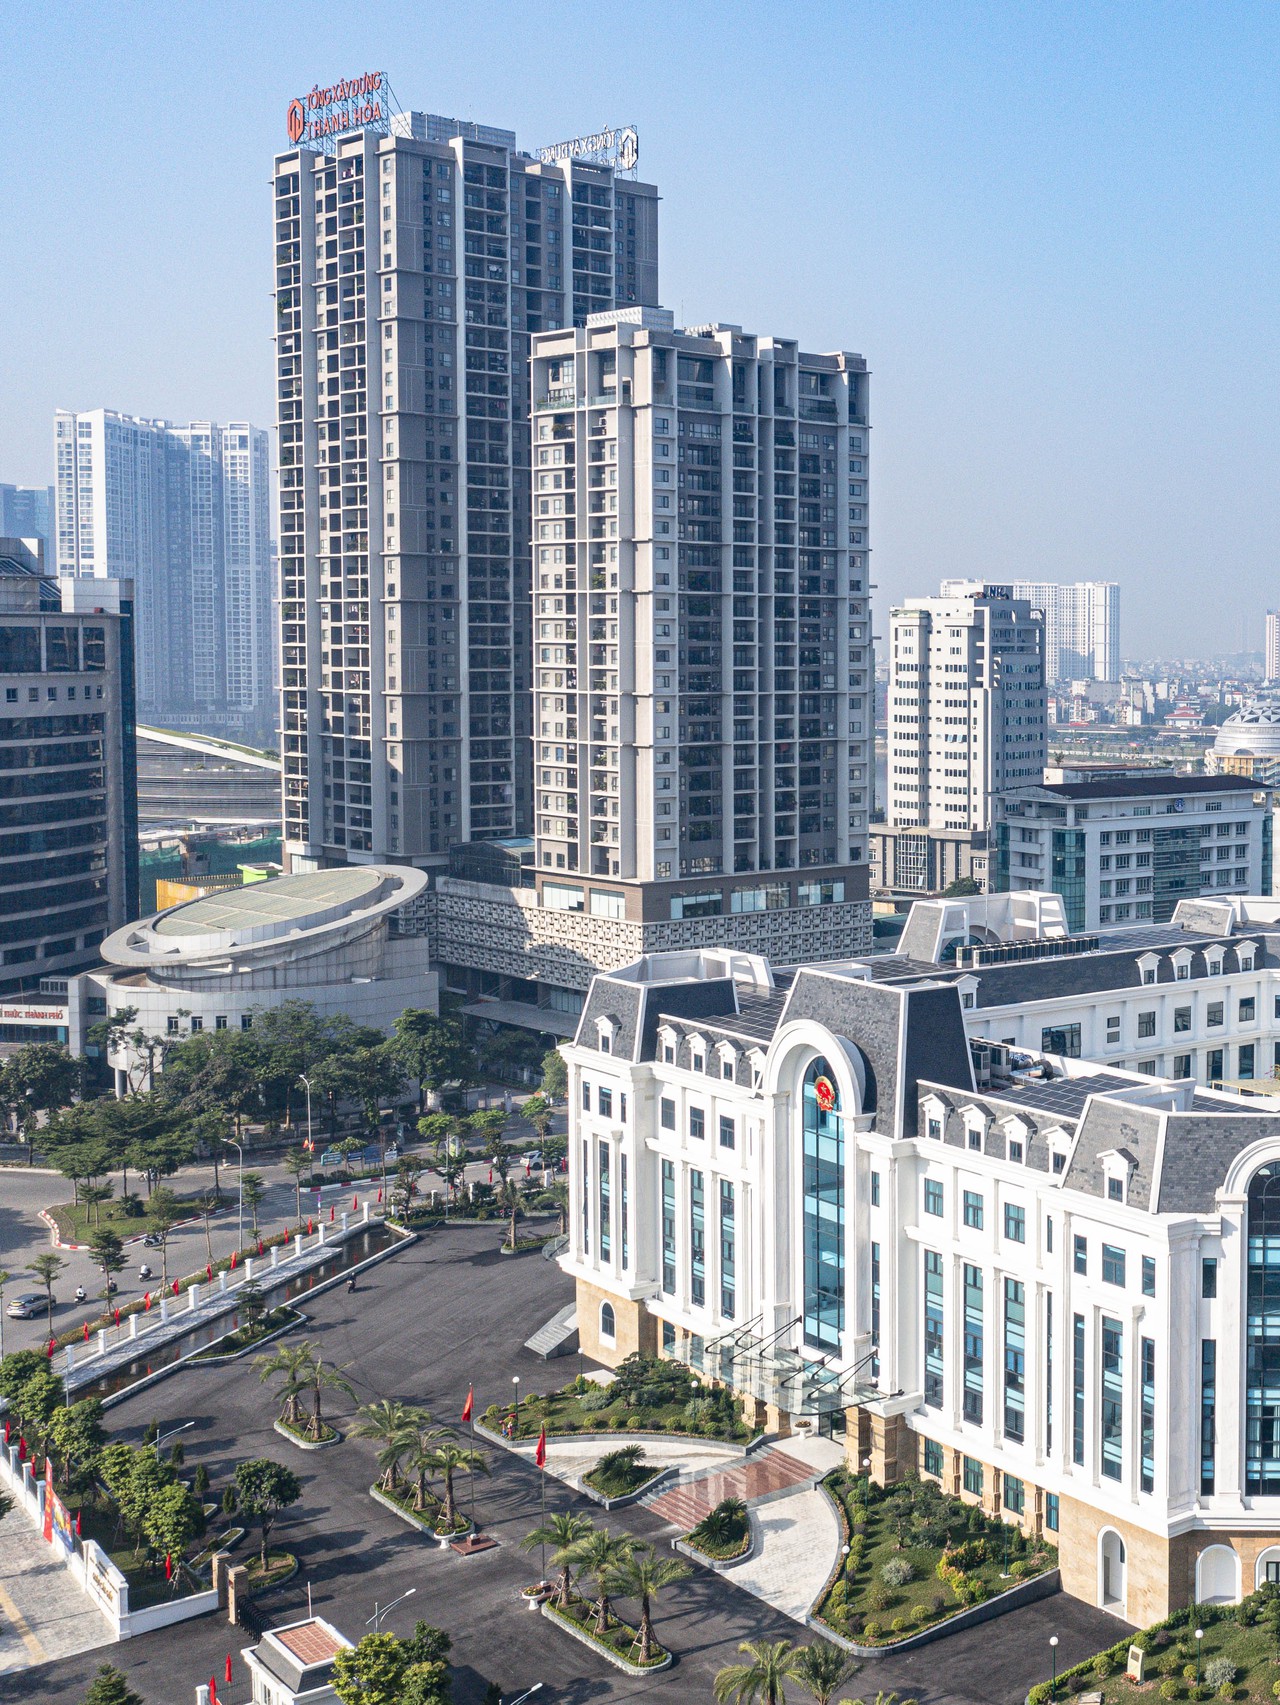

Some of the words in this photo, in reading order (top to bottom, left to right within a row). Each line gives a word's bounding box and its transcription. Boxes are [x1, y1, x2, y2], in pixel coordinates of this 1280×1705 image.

[306, 84, 331, 111] TỔNG
[305, 110, 349, 140] THANH
[353, 98, 381, 126] HÓA
